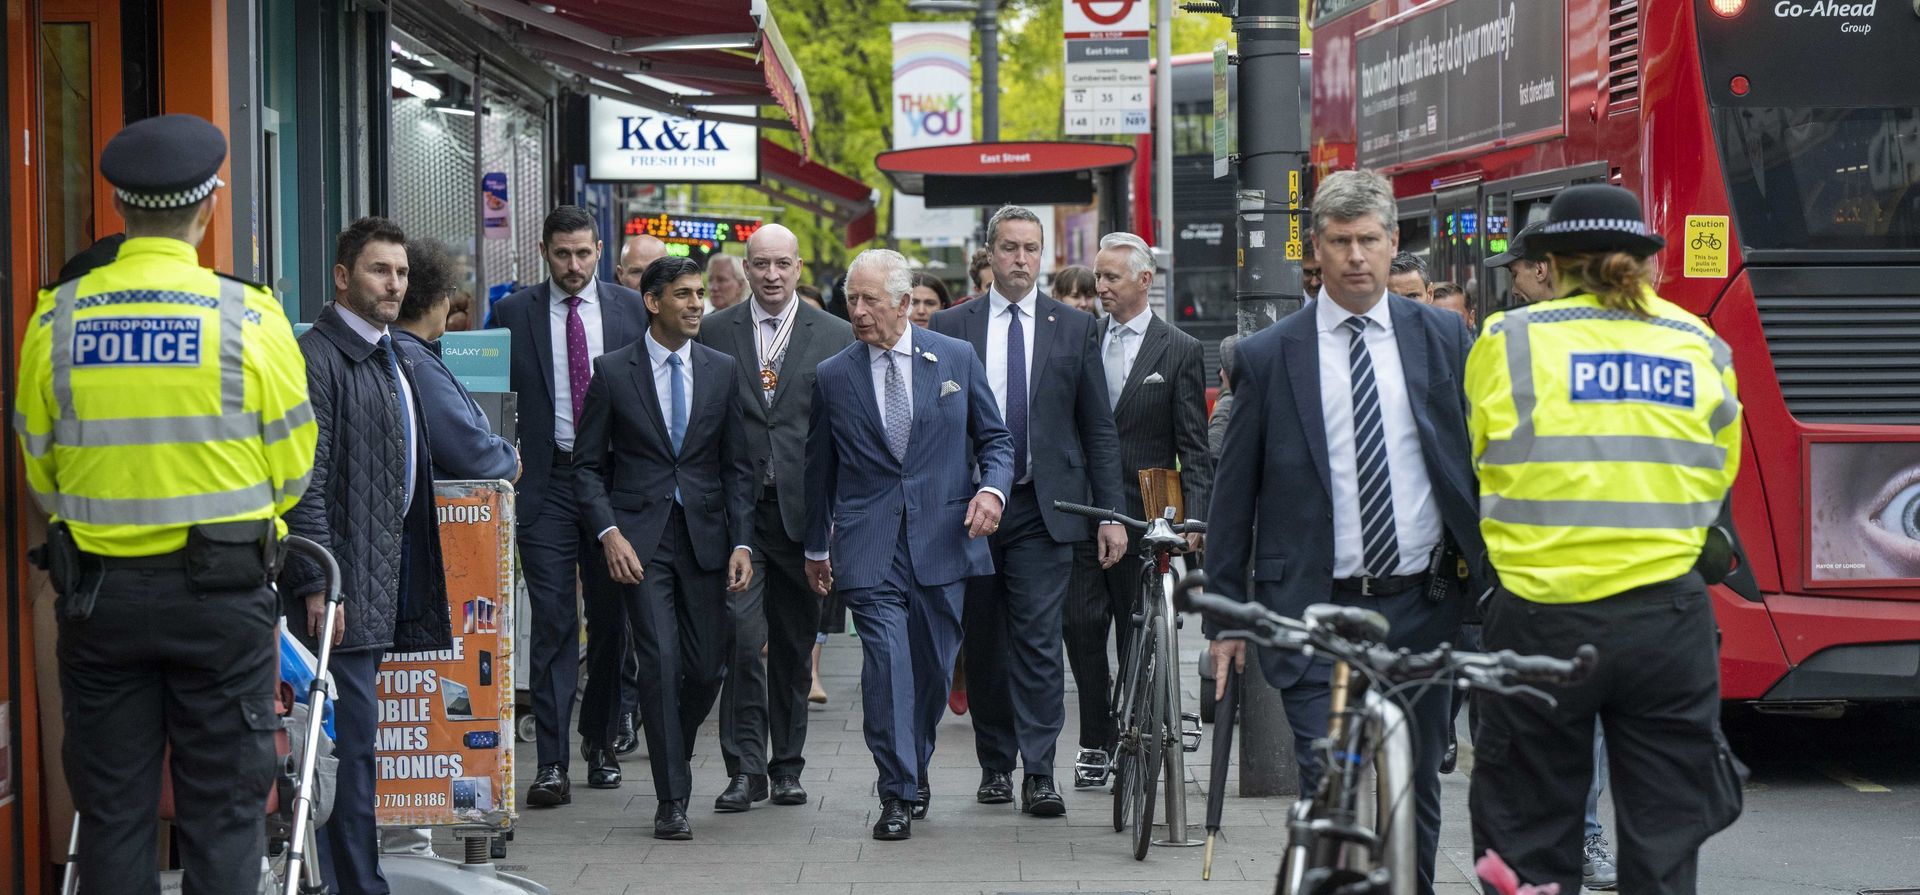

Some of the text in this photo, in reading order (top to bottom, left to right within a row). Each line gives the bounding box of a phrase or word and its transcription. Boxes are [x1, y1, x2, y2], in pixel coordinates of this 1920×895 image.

[1774, 0, 1877, 17] Go-Ahead
[1841, 22, 1872, 35] Group
[1085, 46, 1129, 56] East Street
[1373, 50, 1391, 94] much
[1416, 40, 1423, 80] at
[1424, 35, 1437, 76] the
[1454, 24, 1462, 68] of
[1462, 27, 1480, 75] your
[1480, 1, 1515, 60] money?
[899, 94, 963, 113] THANK
[1075, 93, 1142, 103] 12 35 45
[906, 111, 962, 137] YOU
[1071, 117, 1146, 126] 148 171 N89
[617, 117, 730, 151] K&K
[631, 156, 716, 166] FRESH FISH
[981, 152, 1031, 164] East Street
[78, 320, 198, 332] METROPOLITAN
[76, 332, 197, 363] POLICE
[445, 348, 480, 356] GALAXY
[1575, 361, 1691, 398] POLICE
[384, 794, 411, 808] 7701
[414, 793, 446, 807] 8186
